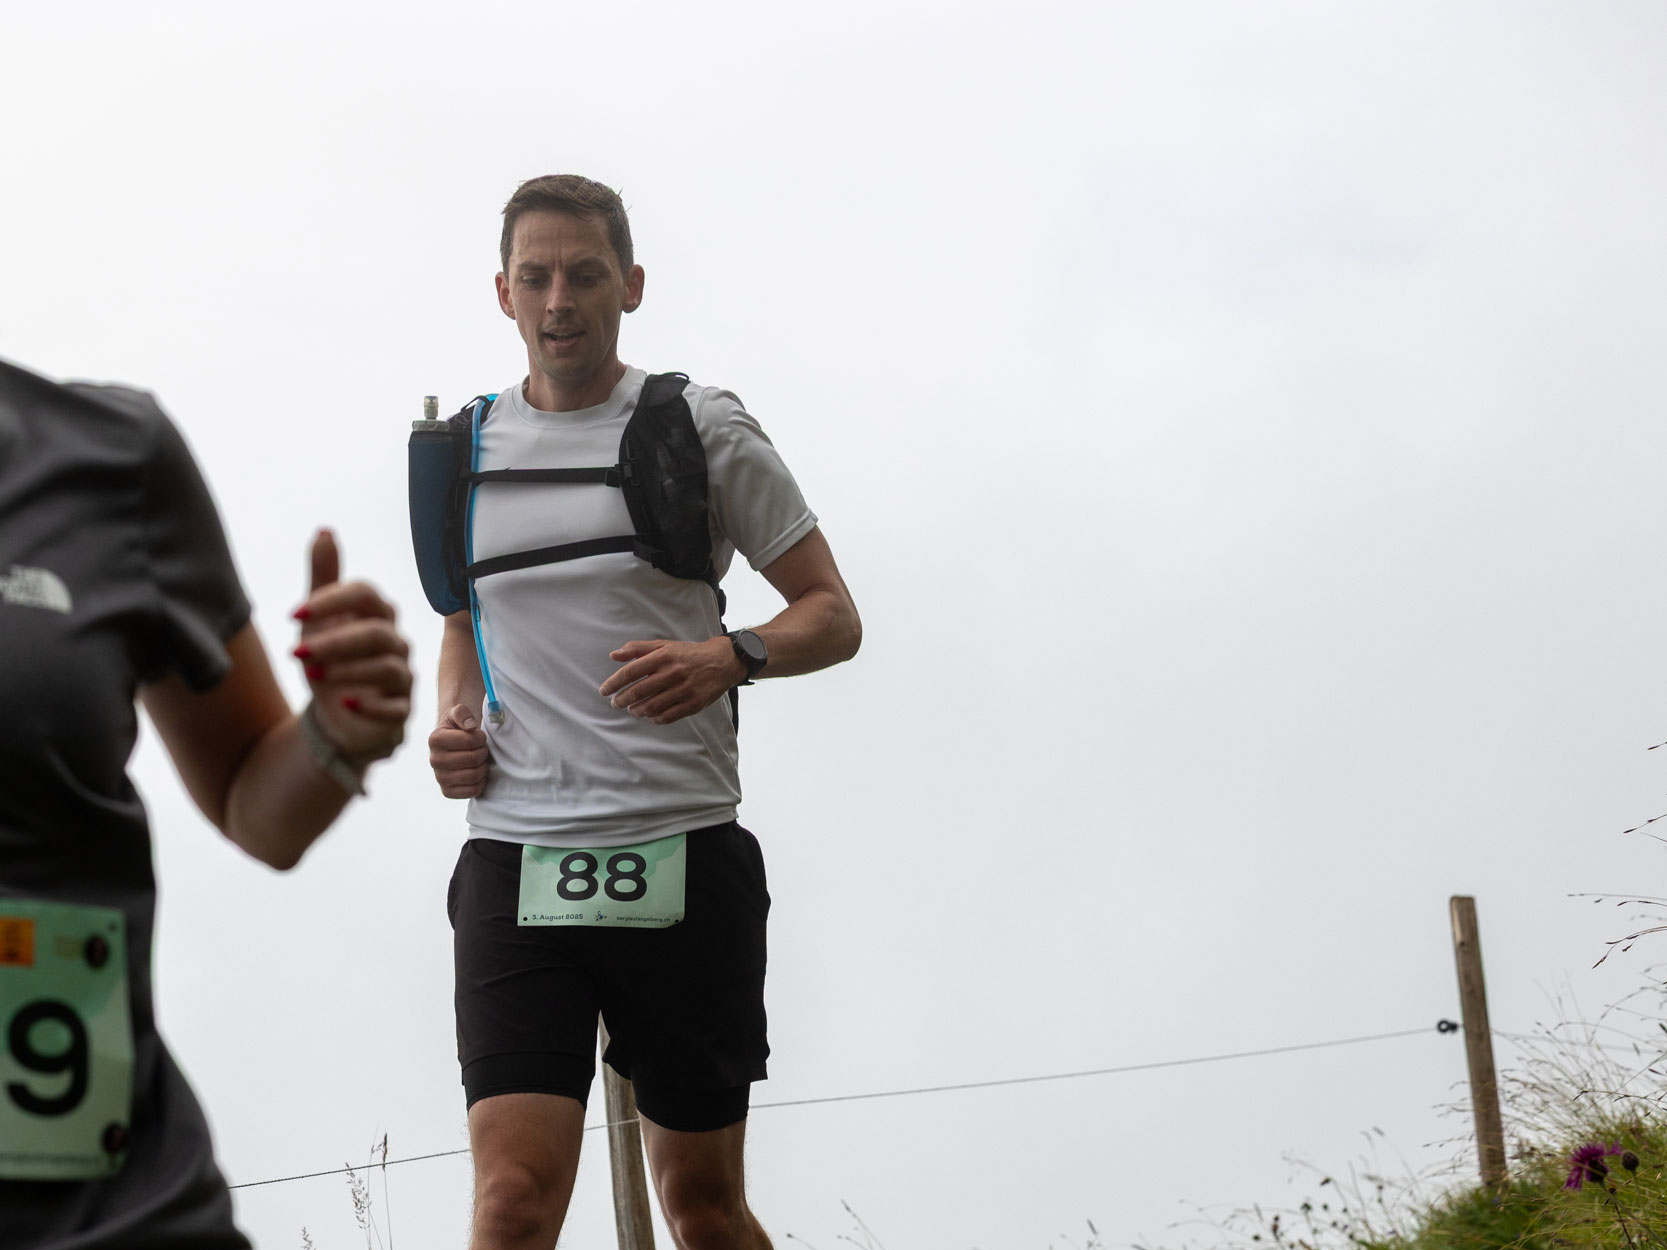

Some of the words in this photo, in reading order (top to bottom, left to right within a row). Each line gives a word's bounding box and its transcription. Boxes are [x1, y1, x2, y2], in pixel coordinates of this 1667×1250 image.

[556, 851, 648, 902] 88
[539, 914, 564, 922] August
[6, 1000, 89, 1117] 9
